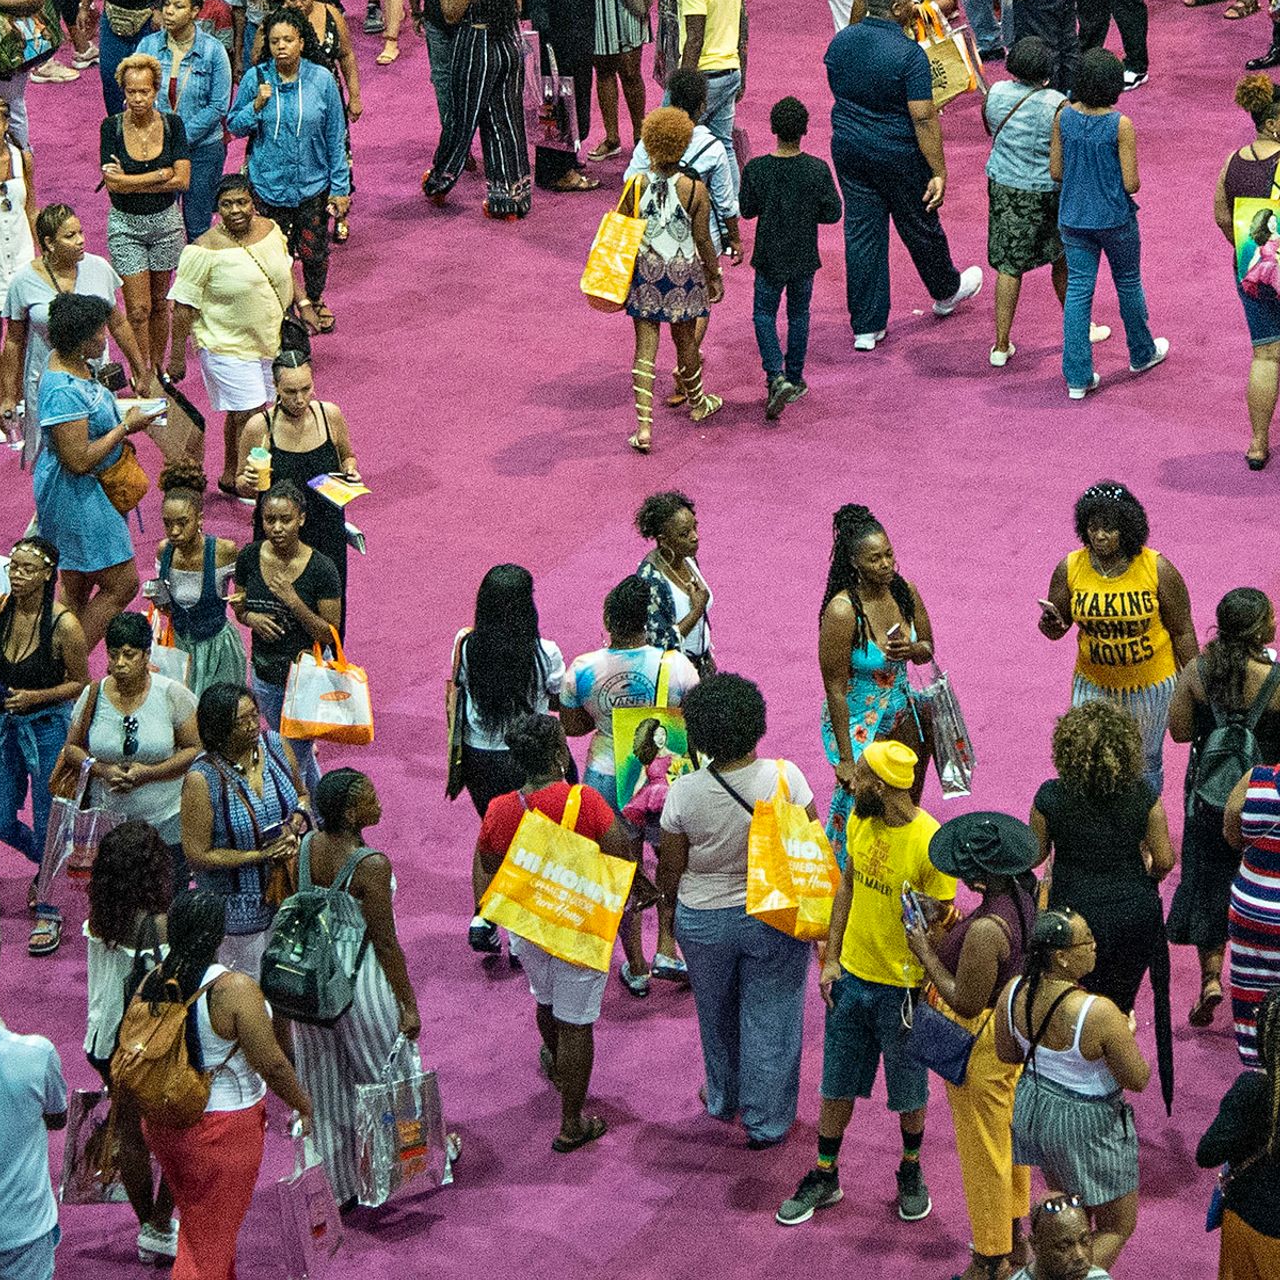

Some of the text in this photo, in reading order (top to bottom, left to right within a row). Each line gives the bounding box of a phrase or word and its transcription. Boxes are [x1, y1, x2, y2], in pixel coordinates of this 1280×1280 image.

[1073, 590, 1155, 617] MAKING
[1081, 618, 1151, 640] MONEY
[1088, 636, 1155, 667] MOVES
[513, 847, 542, 874] HI
